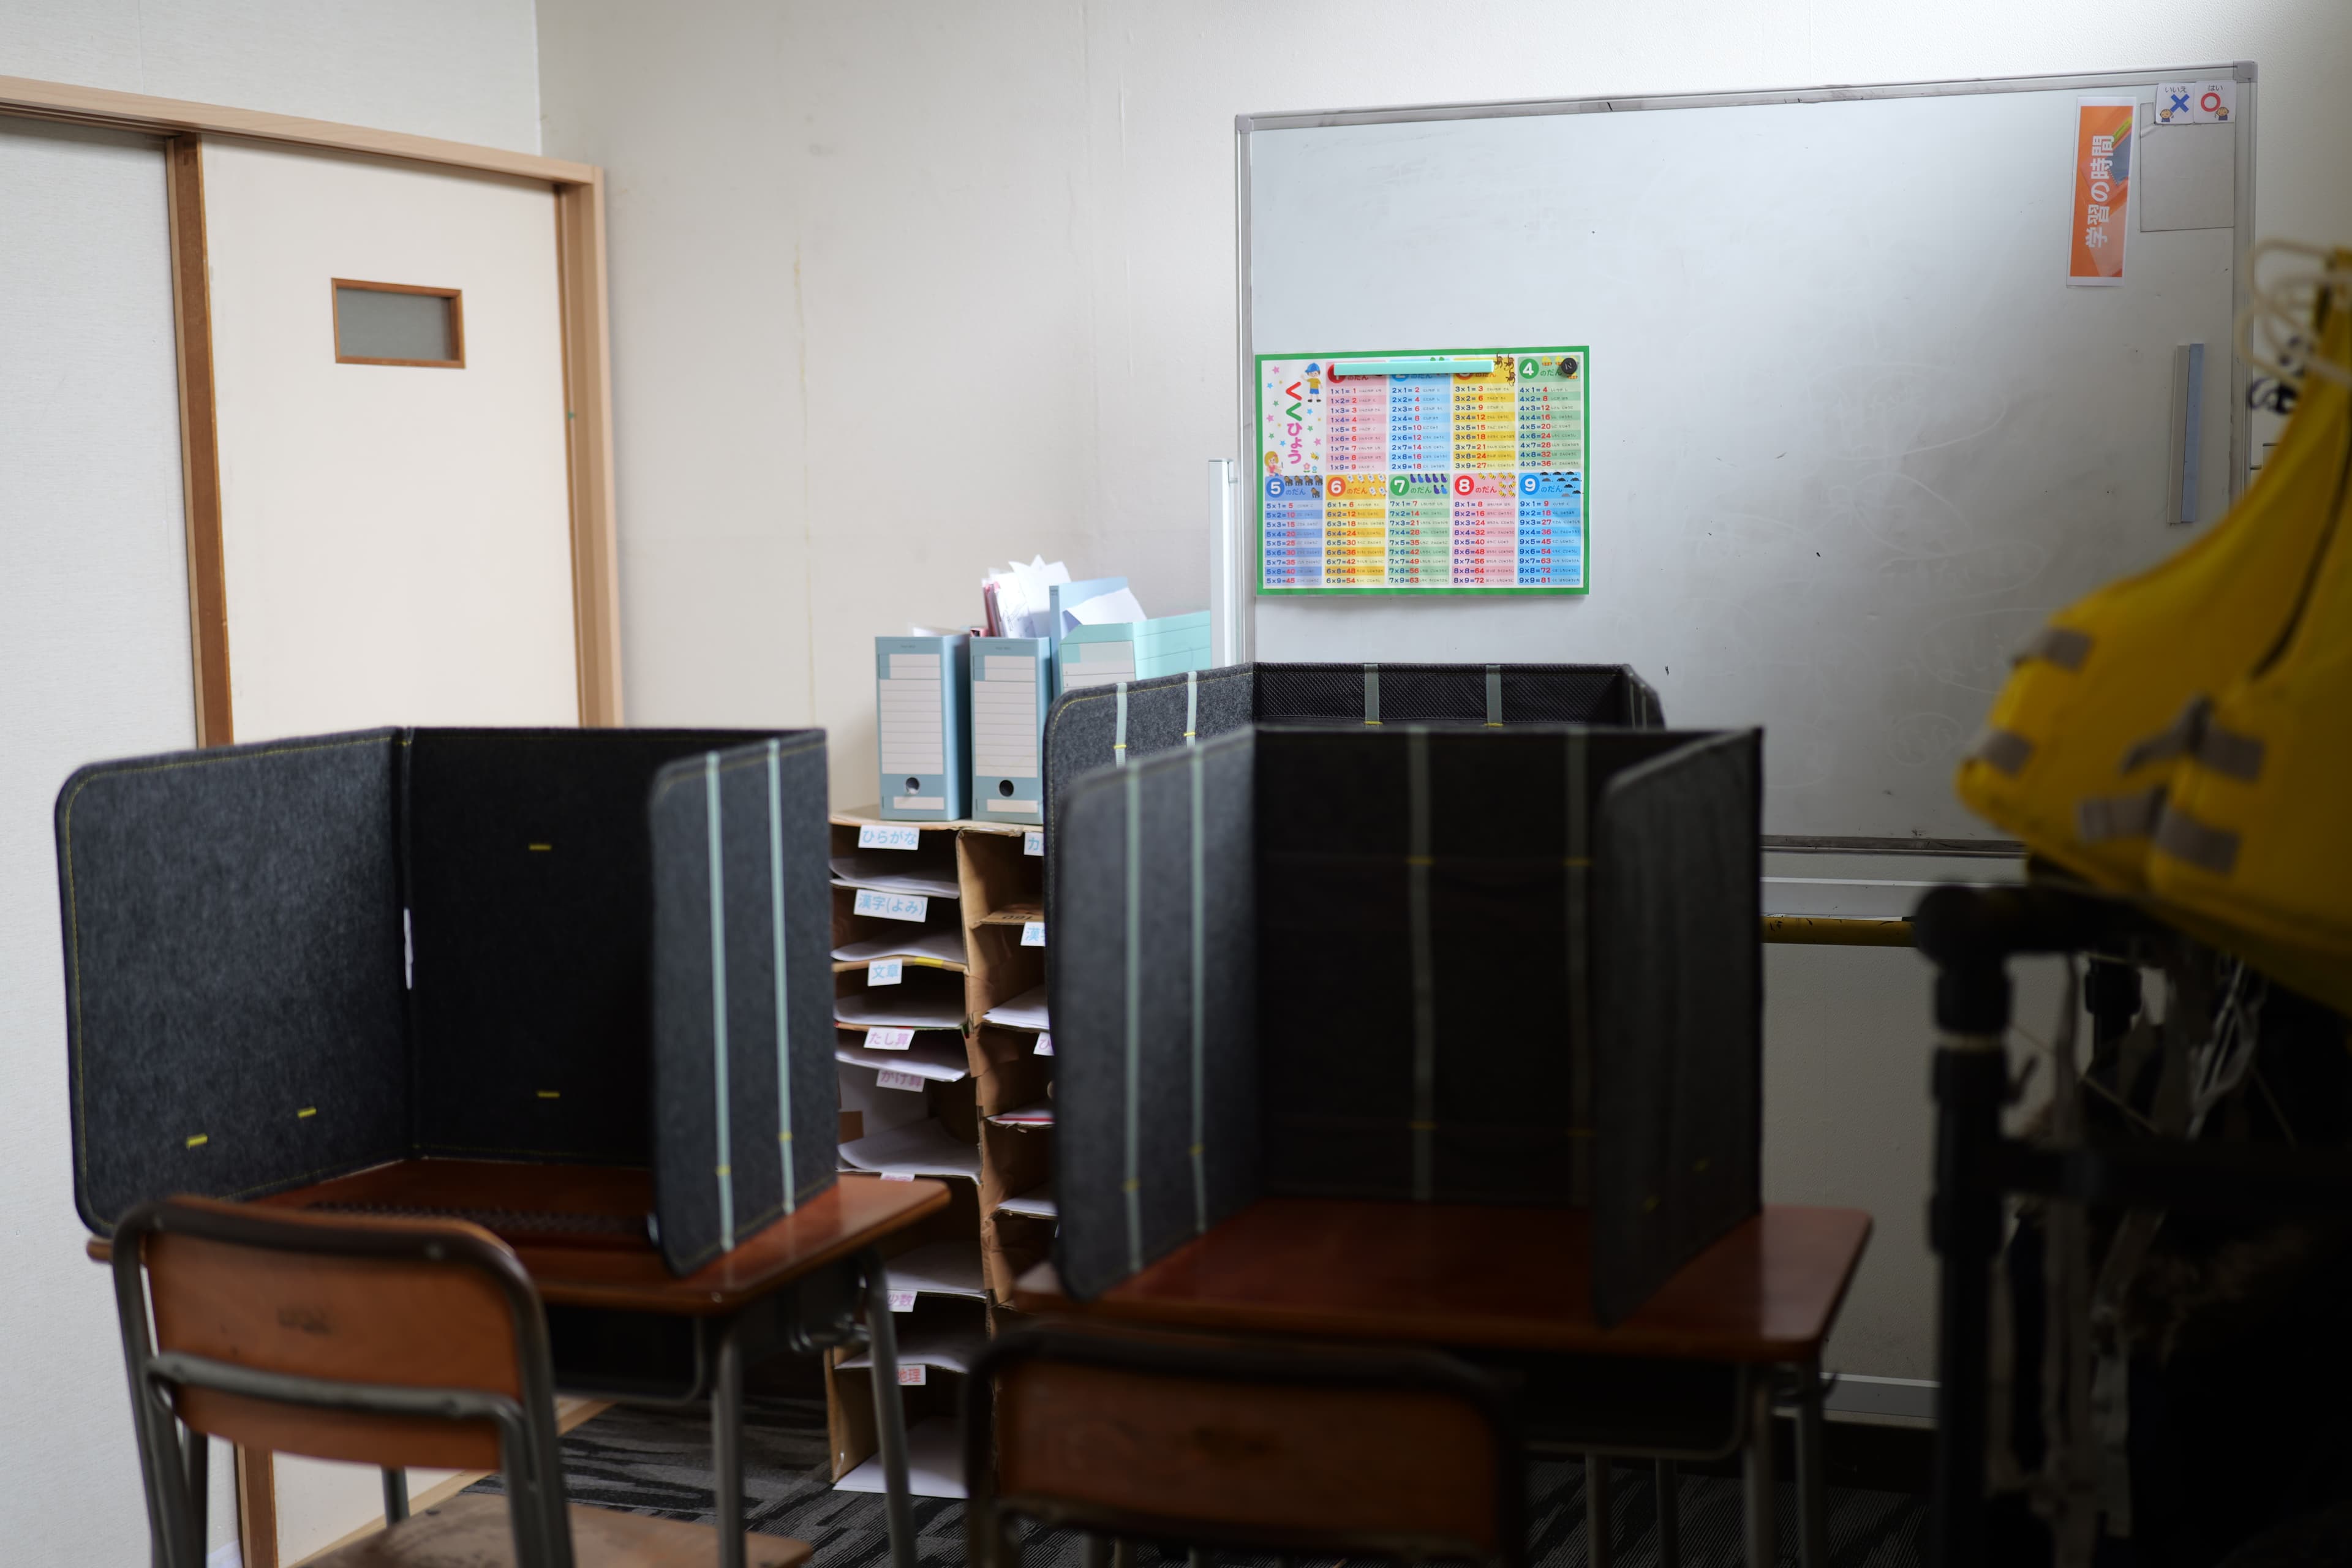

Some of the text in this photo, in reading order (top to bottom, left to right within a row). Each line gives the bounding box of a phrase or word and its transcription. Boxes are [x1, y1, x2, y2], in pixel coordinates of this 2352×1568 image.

[2086, 135, 2114, 248] 学習の時間
[1286, 382, 1302, 464] くくひょう
[862, 829, 916, 845] ひらがな
[858, 893, 924, 916] 漢字(よみ)
[872, 965, 898, 979] 文章
[869, 1031, 908, 1046] たし算
